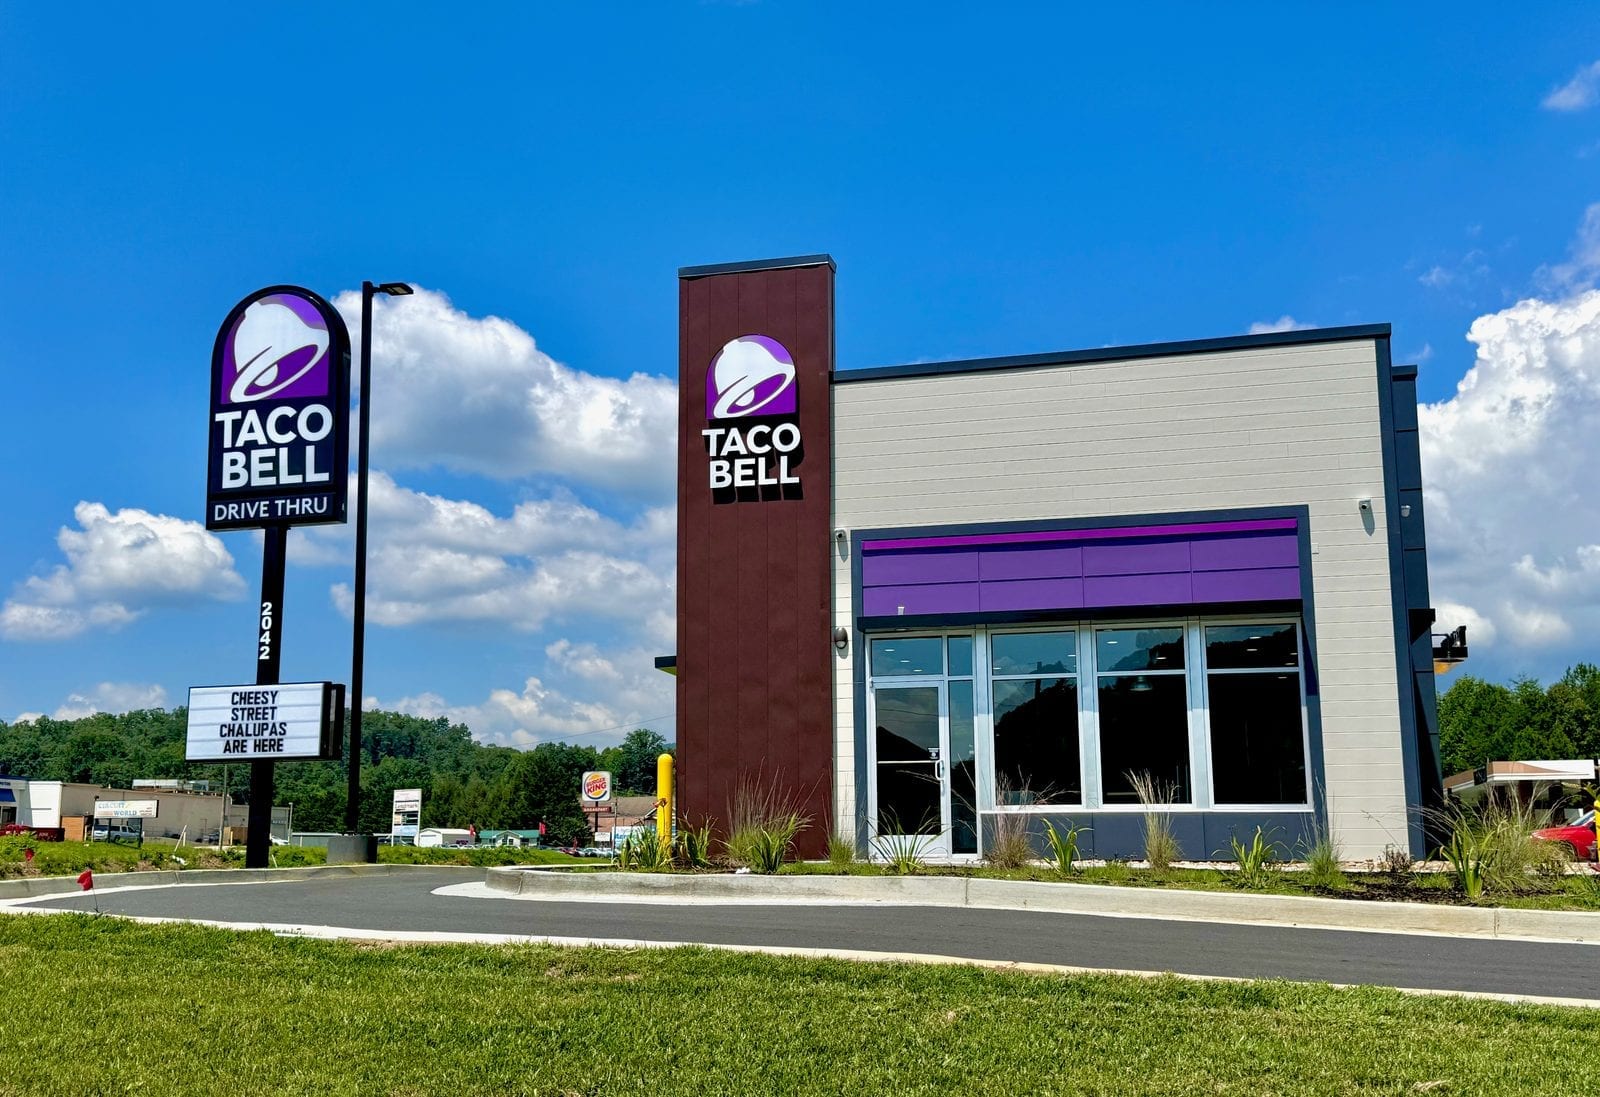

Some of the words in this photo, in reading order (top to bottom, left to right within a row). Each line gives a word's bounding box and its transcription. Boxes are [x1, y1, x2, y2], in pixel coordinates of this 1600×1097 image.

[215, 403, 333, 449] TACO
[702, 422, 801, 457] TACO
[222, 445, 330, 489] BELL
[709, 455, 800, 489] BELL
[214, 500, 270, 521] DRIVE
[274, 496, 328, 517] THRU
[258, 602, 273, 660] 2042
[231, 690, 279, 705] CHEESY
[231, 706, 278, 721] STREET
[219, 722, 287, 738] CHALUPAS
[223, 739, 247, 754] ARE
[253, 738, 284, 753] HERE
[586, 777, 606, 787] BURGER
[587, 782, 607, 794] KING
